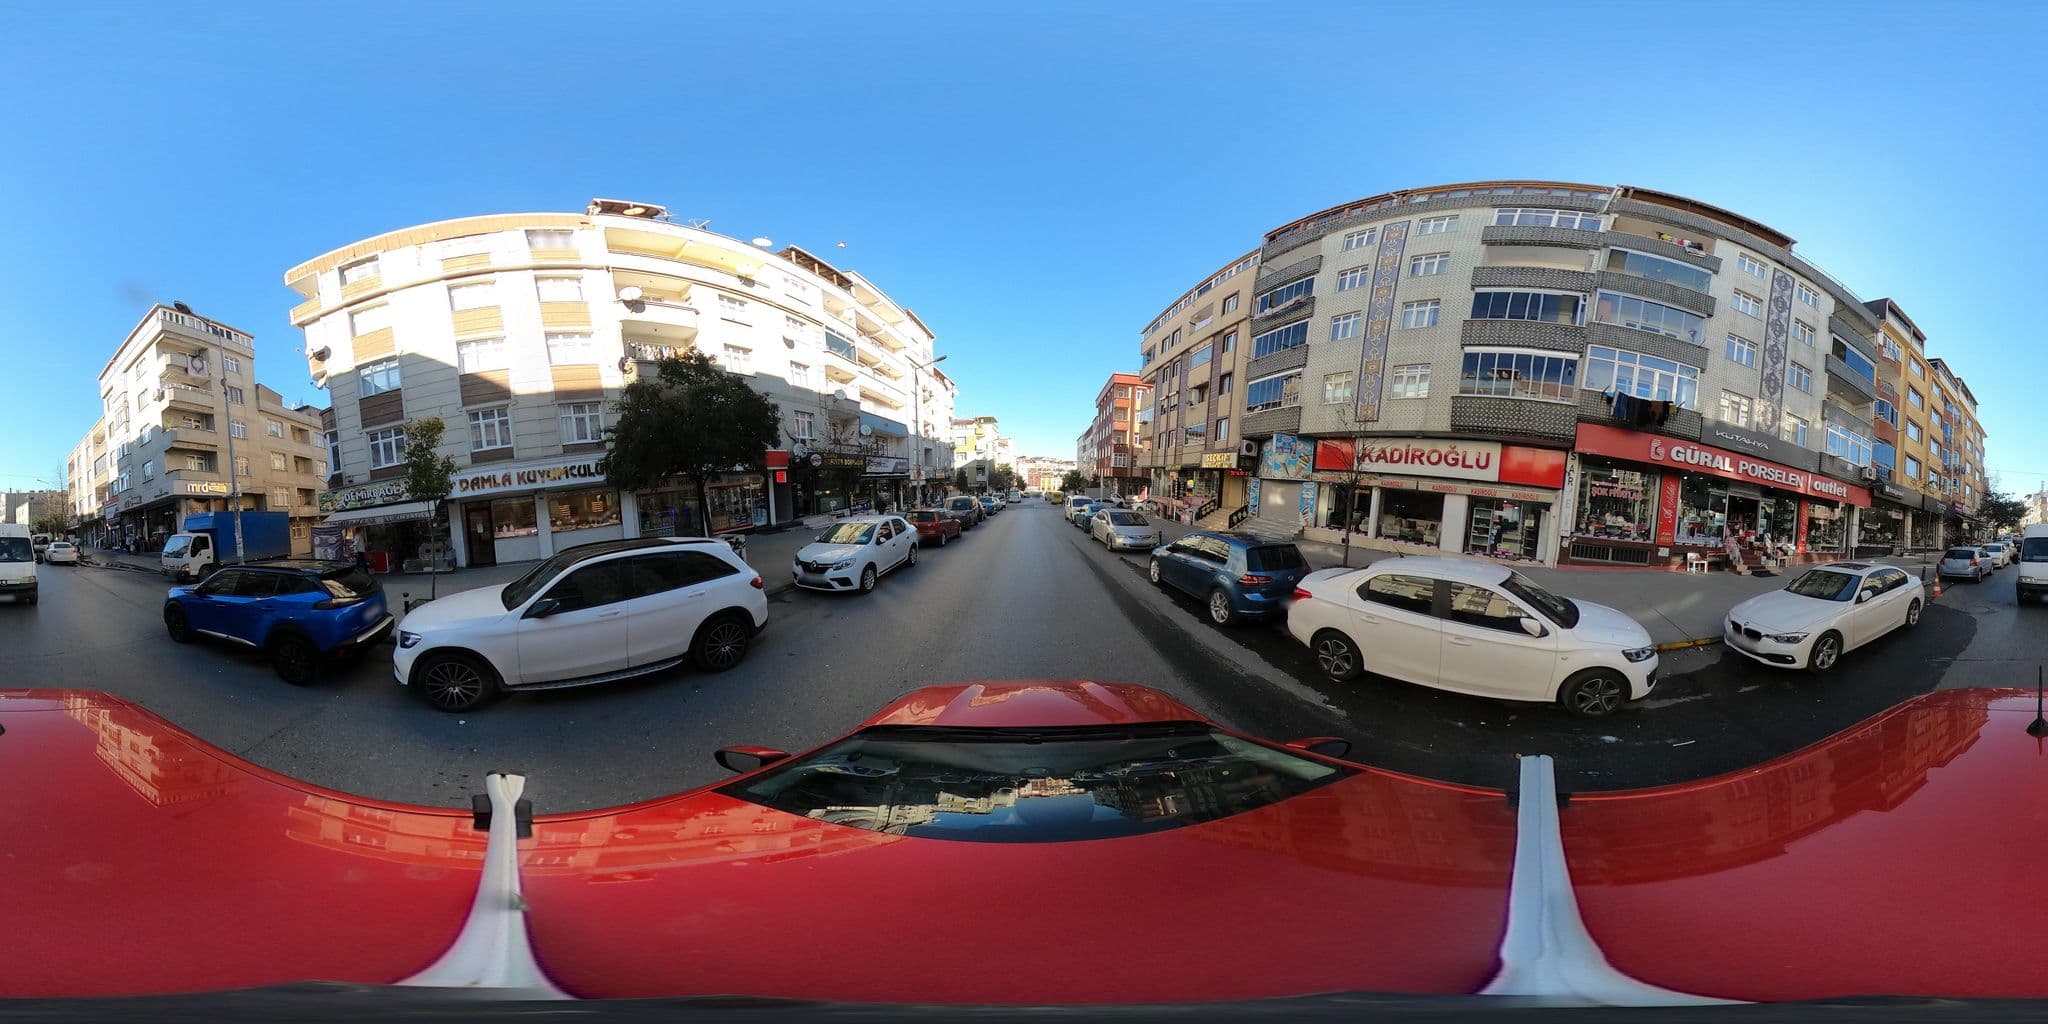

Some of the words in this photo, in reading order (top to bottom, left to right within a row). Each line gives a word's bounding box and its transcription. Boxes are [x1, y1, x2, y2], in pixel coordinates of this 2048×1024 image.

[1360, 443, 1491, 470] KADİROĞLU
[1670, 445, 1734, 472] GÜRAL
[1738, 460, 1804, 488] PORSELEN
[1813, 479, 1848, 498] outlet
[459, 471, 512, 493] DAMLA
[517, 463, 607, 486] KUYUMCULU
